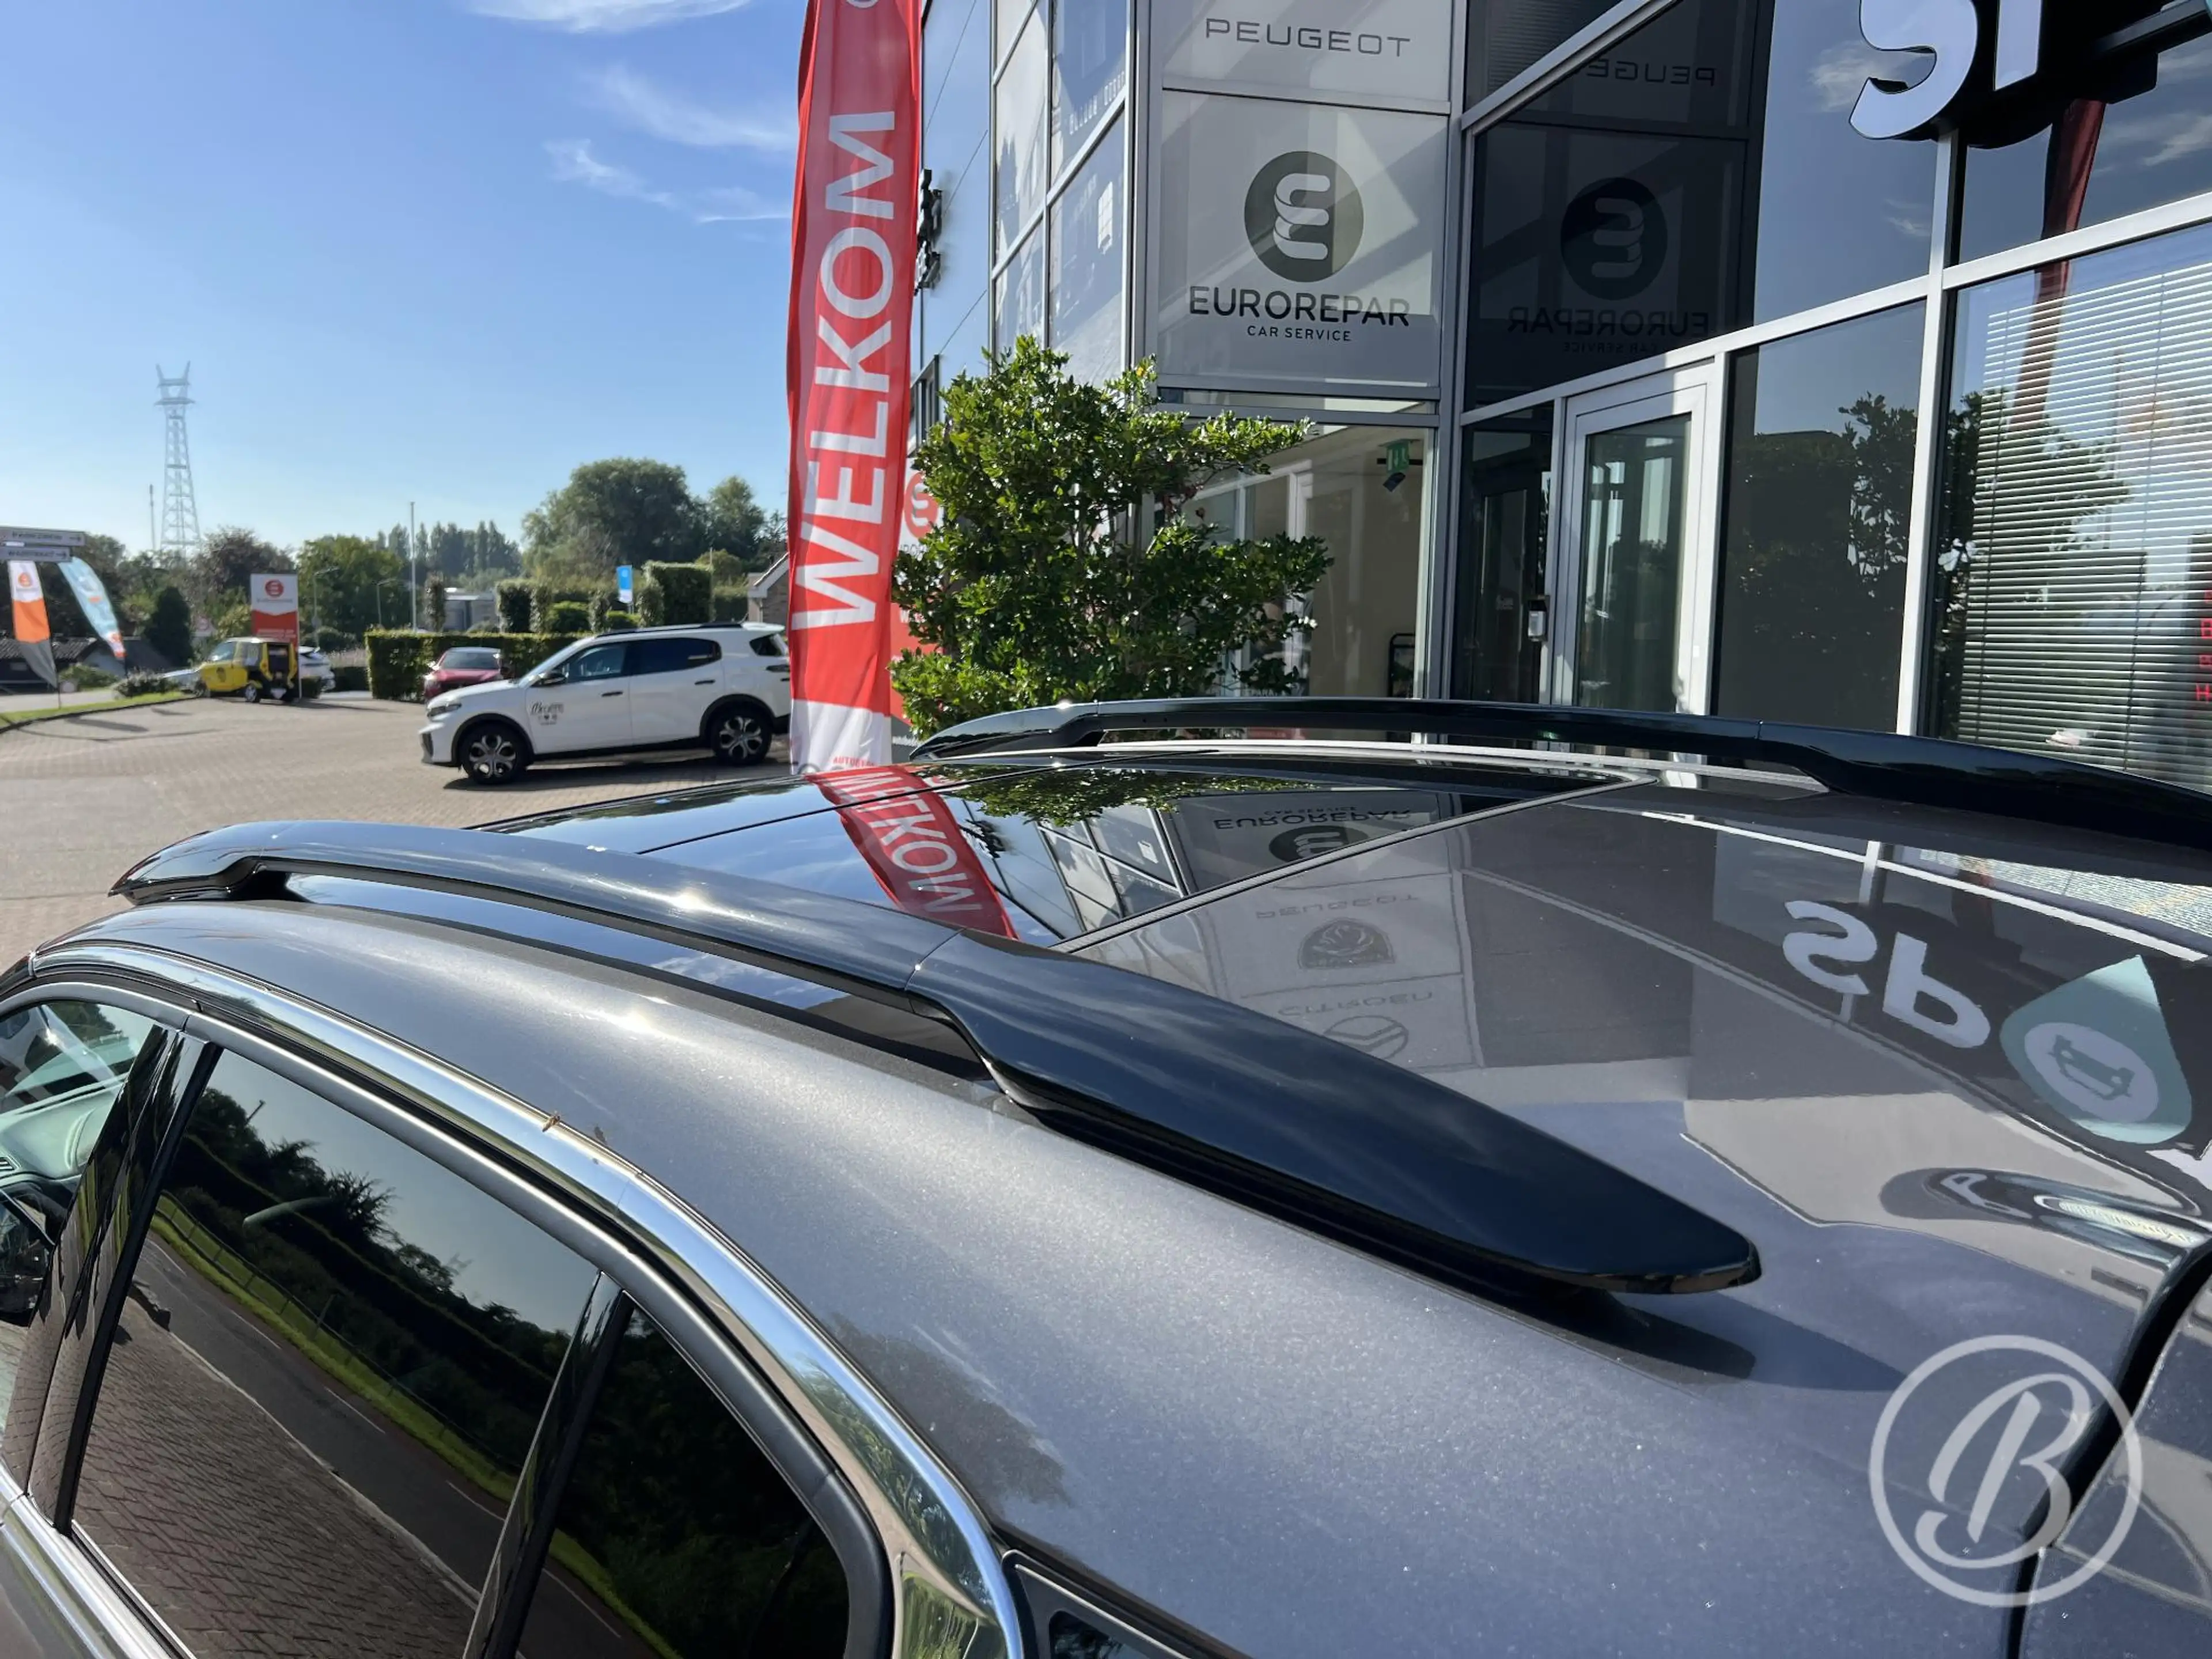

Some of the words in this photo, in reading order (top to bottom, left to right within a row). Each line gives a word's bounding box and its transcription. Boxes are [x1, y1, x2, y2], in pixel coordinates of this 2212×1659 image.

[1206, 18, 1410, 56] PEUGEOT
[1190, 286, 1410, 326] EUROREPAR
[1247, 325, 1278, 338] CAR
[1285, 327, 1351, 341] SERVICE
[791, 111, 895, 630] WELKOM
